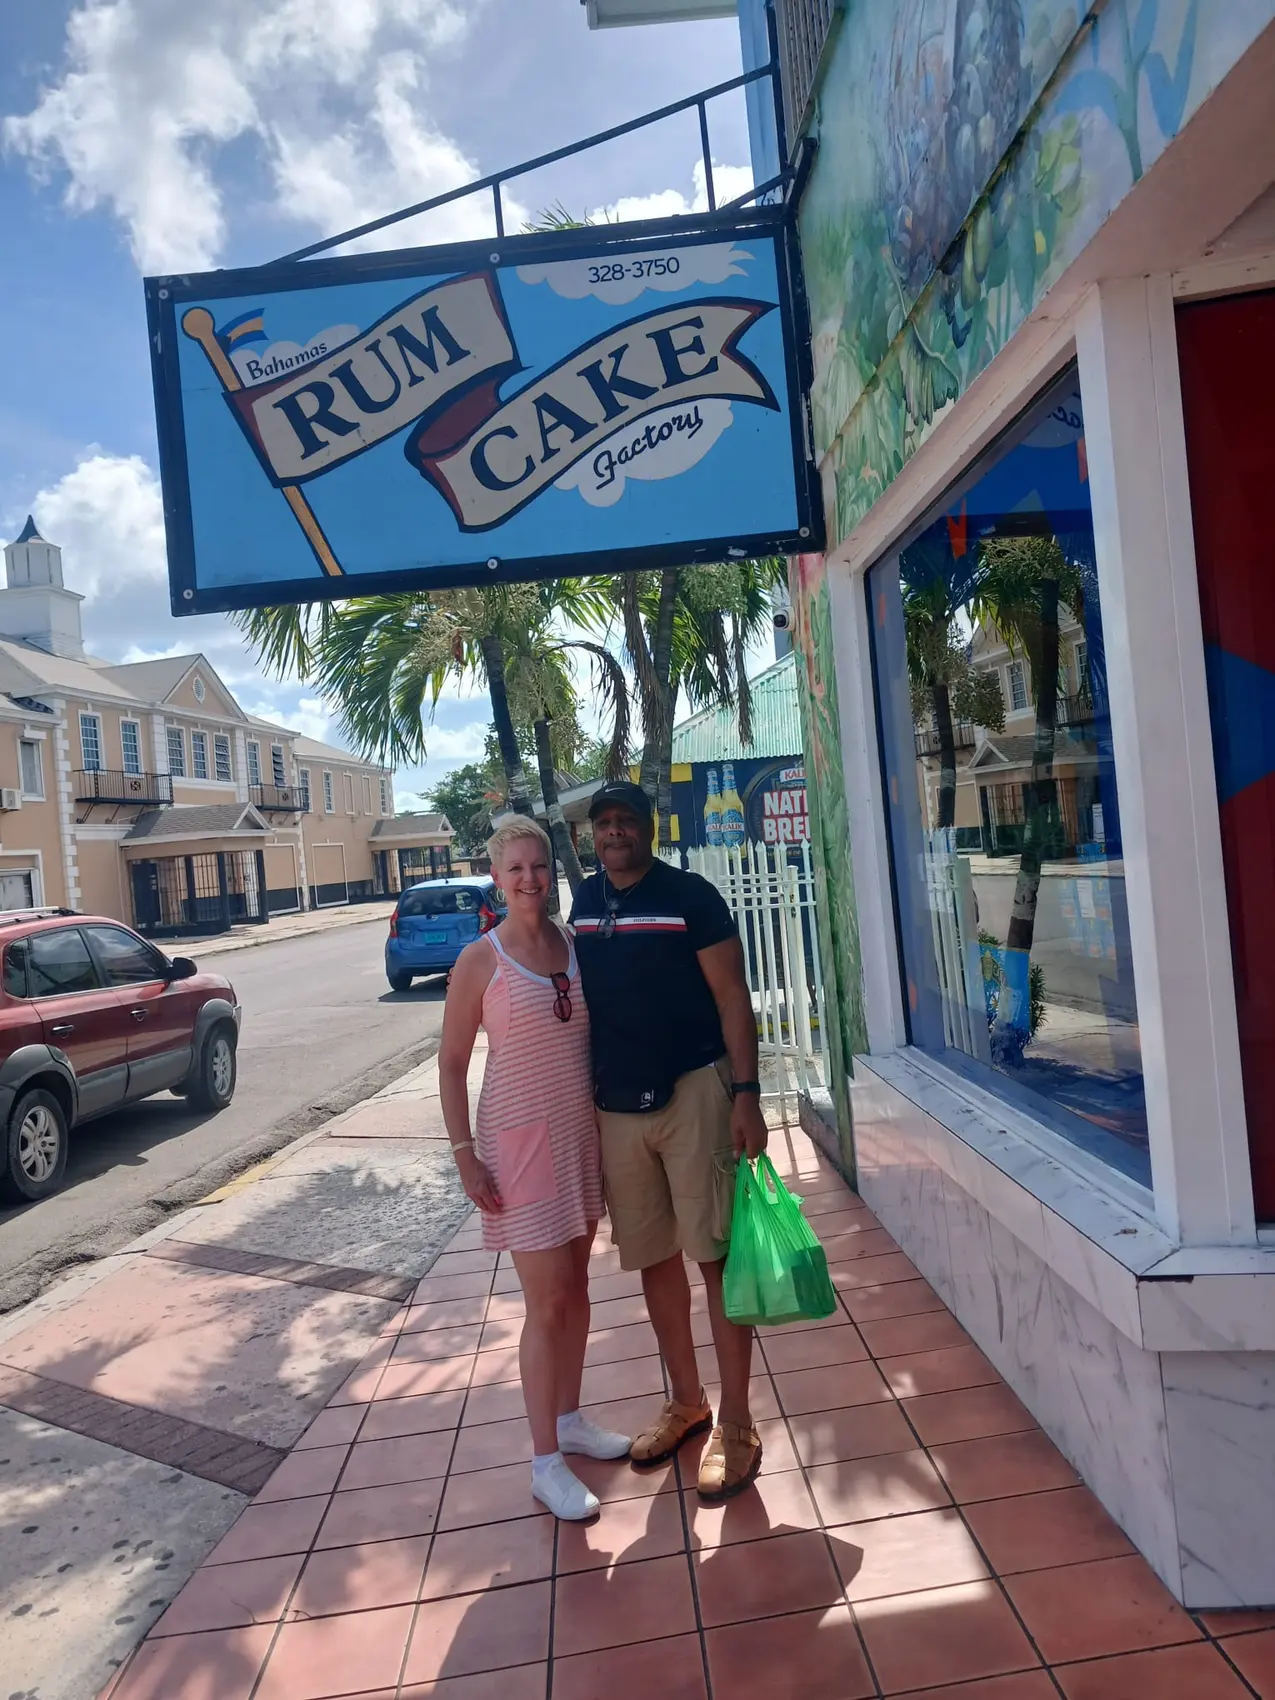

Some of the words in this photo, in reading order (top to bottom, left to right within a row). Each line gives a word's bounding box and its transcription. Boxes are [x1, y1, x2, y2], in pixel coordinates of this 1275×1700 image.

[588, 257, 681, 284] 328-3750
[245, 342, 328, 381] Bahamas
[272, 305, 471, 460] RUM
[470, 316, 719, 492] CAKE
[593, 405, 703, 490] Factory
